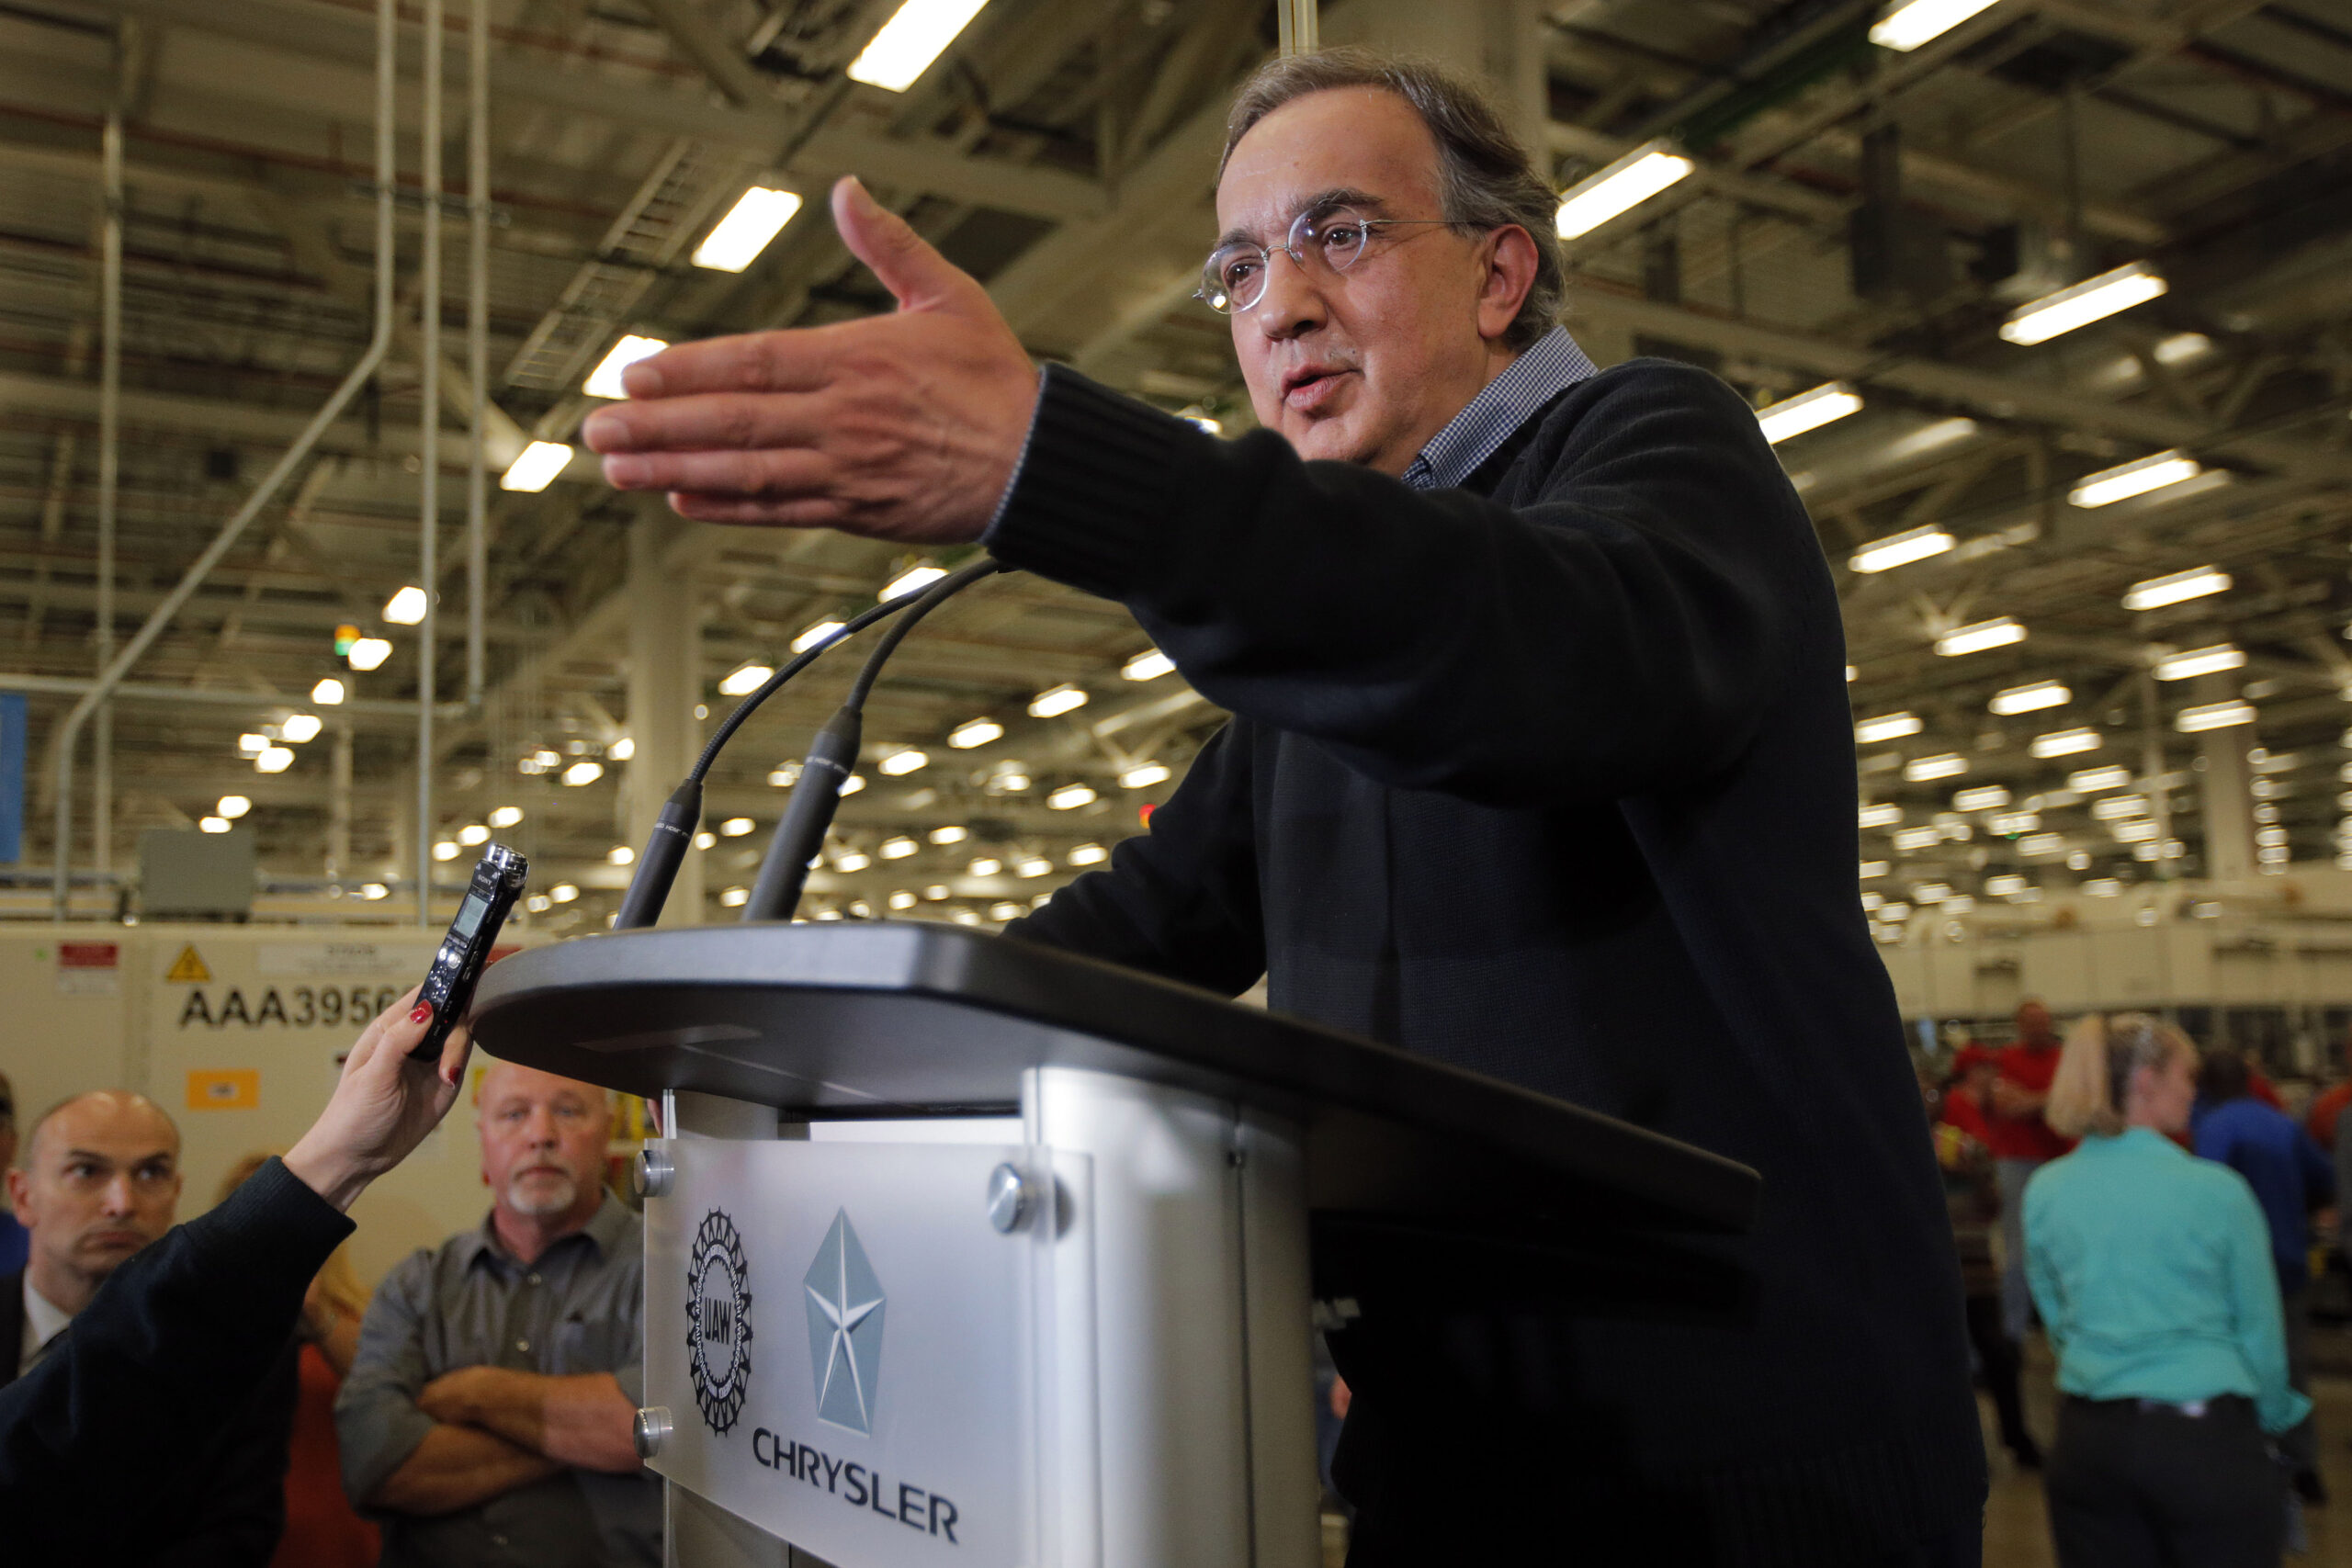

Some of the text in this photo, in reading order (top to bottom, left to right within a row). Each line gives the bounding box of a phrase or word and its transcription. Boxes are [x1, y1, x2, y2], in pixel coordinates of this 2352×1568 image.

[478, 874, 492, 886] SONY
[179, 985, 417, 1029] AAA3956
[705, 1297, 732, 1345] UAW
[752, 1427, 958, 1544] CHRYSLER
